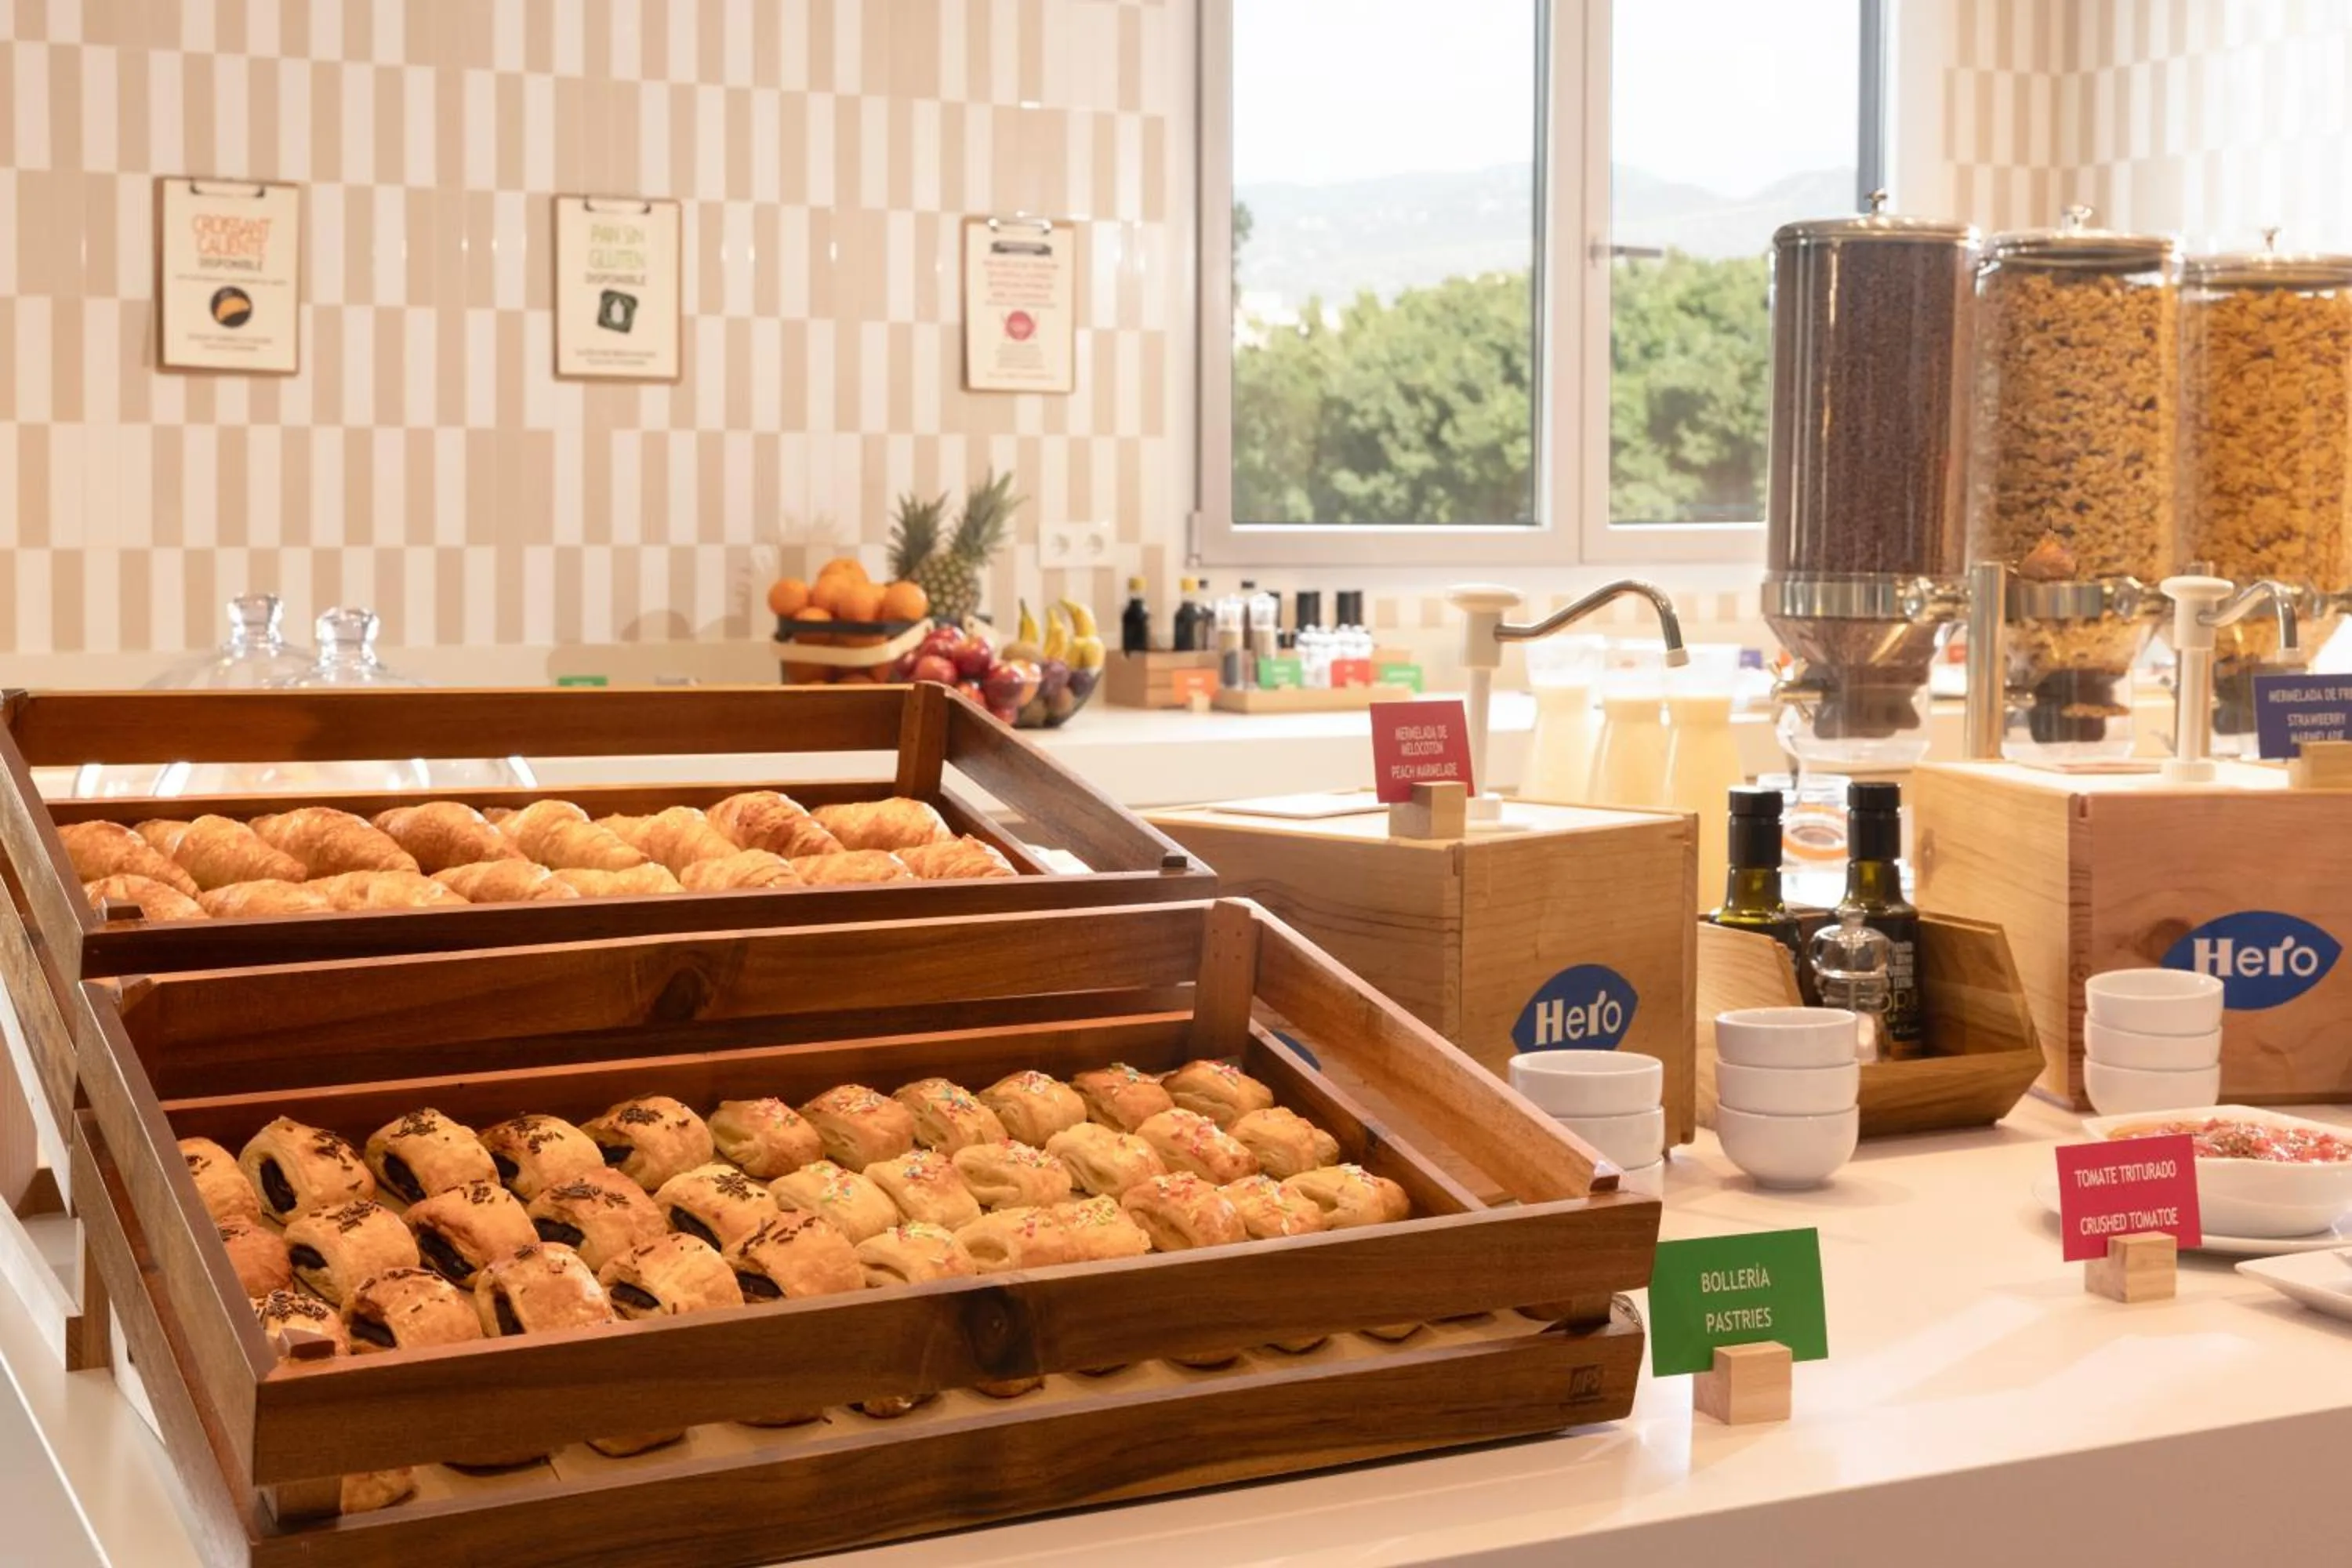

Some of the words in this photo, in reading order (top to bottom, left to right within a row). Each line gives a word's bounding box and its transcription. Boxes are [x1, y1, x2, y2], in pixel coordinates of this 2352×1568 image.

[588, 249, 647, 270] GLUTEN
[2268, 688, 2322, 702] MERMELADA
[2325, 687, 2336, 701] DE
[1395, 724, 1436, 741] MERMELADA
[1437, 724, 1448, 739] DE
[2287, 713, 2346, 727] STRAWBERRY
[1391, 764, 1415, 779] PEACH
[1416, 762, 1458, 778] MARMELADE
[2193, 935, 2318, 977] Hero
[1534, 989, 1622, 1046] Hero
[2074, 1166, 2118, 1189] TOMATE
[2118, 1160, 2176, 1183] TRITURADO
[2080, 1213, 2127, 1236] CRUSHED
[2129, 1207, 2180, 1229] TOMATOE
[1700, 1262, 1771, 1293] BOLLERÍA
[1705, 1308, 1773, 1334] PASTRIES
